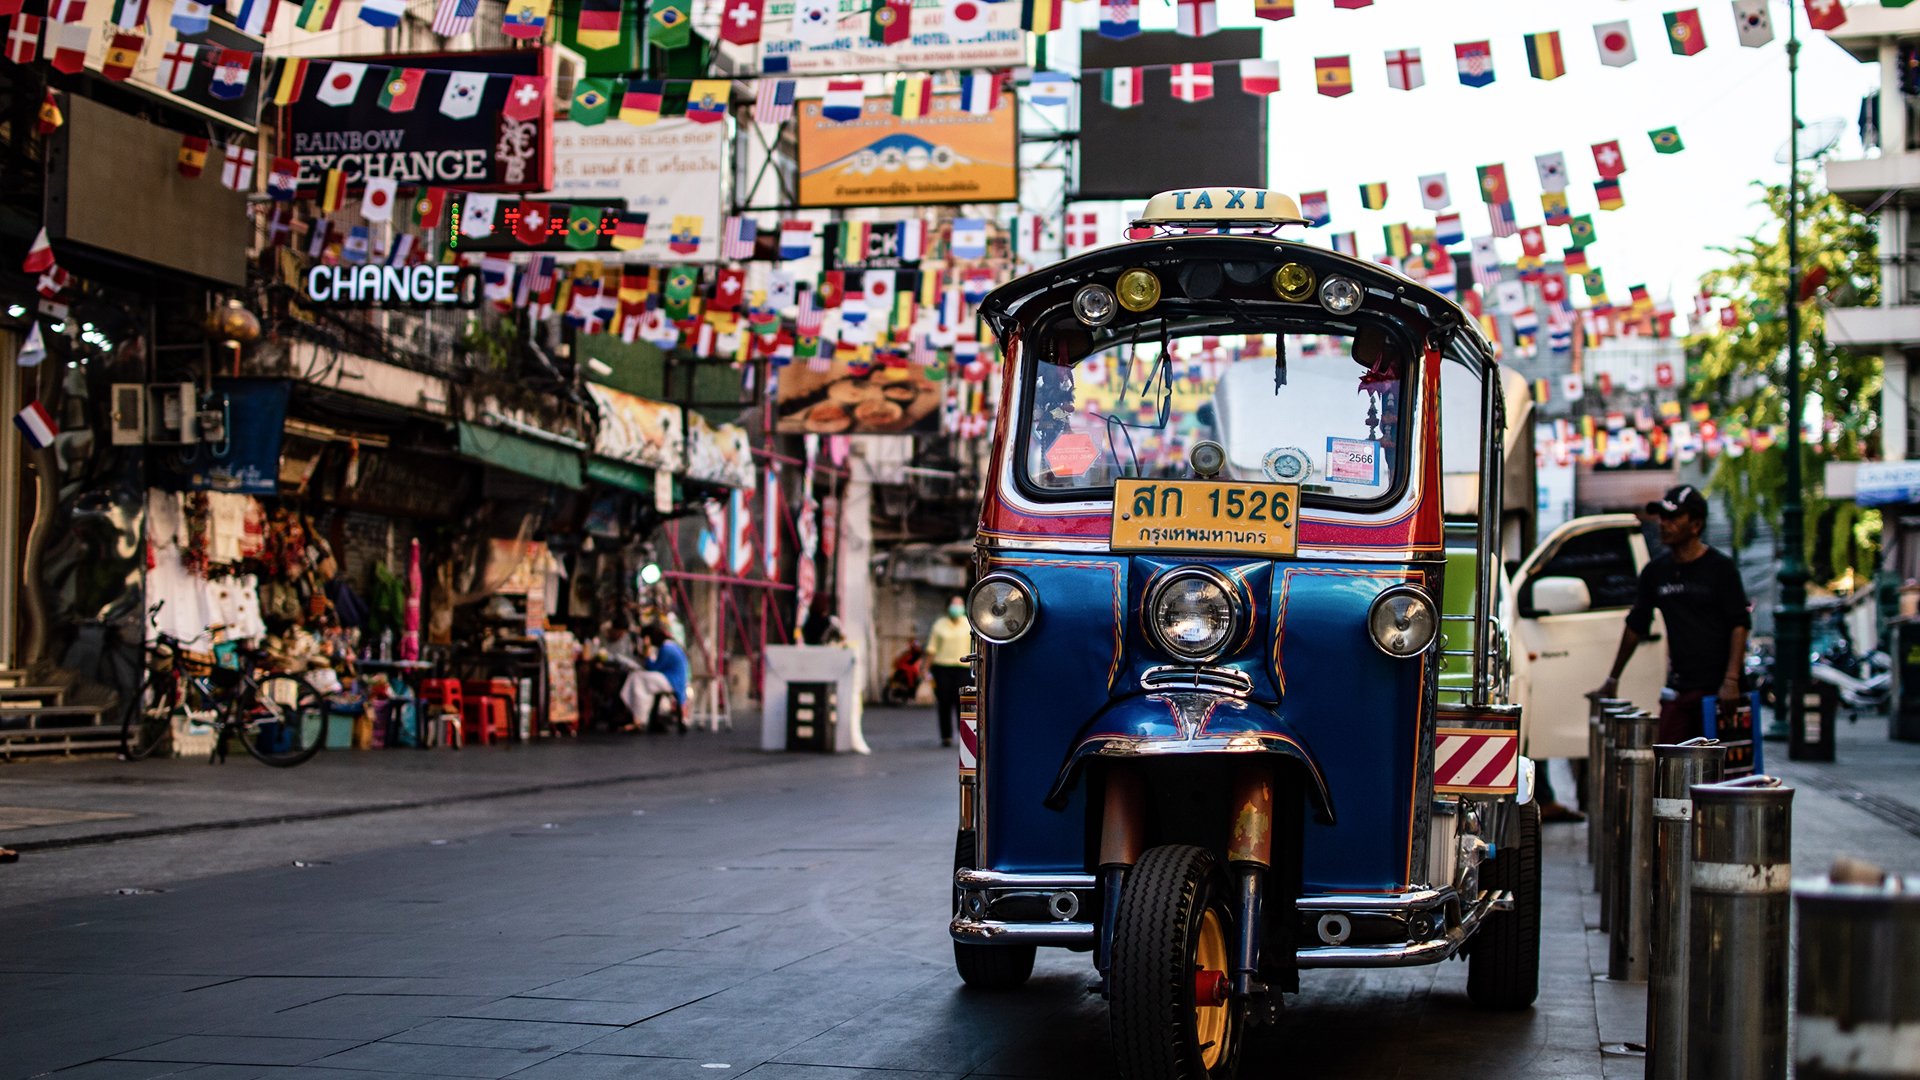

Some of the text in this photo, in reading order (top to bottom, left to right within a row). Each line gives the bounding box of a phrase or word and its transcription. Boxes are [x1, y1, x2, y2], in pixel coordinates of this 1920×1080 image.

[957, 29, 1020, 45] KING
[295, 129, 405, 152] RAINBOW
[1172, 189, 1267, 210] TAXI
[308, 264, 459, 303] CHANGE
[1348, 453, 1374, 465] 2566
[1133, 484, 1291, 523] สก 1526
[1139, 527, 1268, 546] กรุงเทพมหานคร
